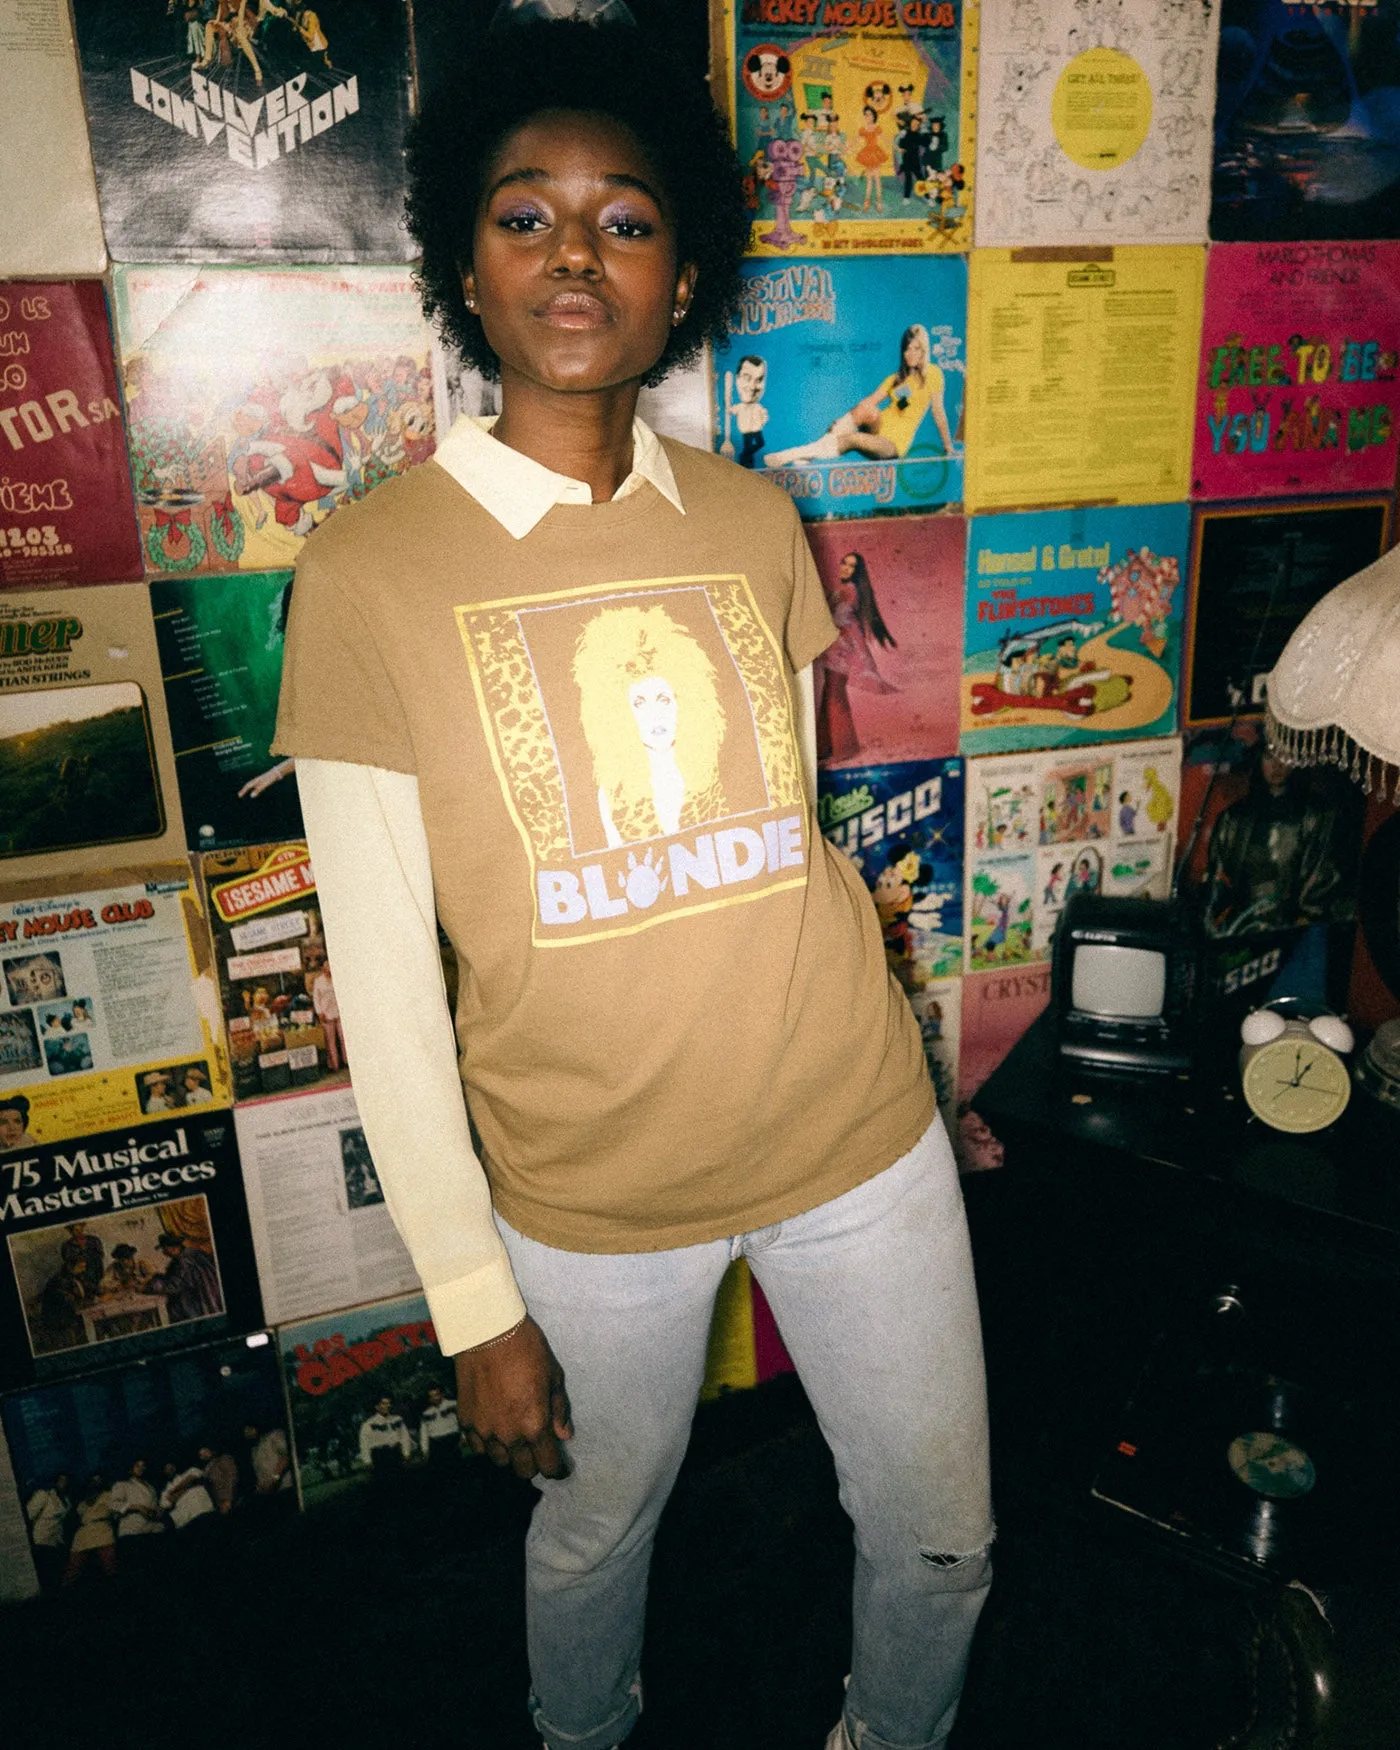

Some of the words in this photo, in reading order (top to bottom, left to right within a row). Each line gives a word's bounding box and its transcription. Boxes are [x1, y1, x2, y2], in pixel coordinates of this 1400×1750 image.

[902, 1, 955, 27] CLUB
[1295, 344, 1332, 385] TO
[1207, 413, 1271, 455] YOU
[977, 593, 1095, 622] FLINTSTONES
[23, 907, 97, 939] MOUSE
[100, 898, 155, 924] CLUB
[2, 1158, 42, 1191] 75
[53, 1128, 190, 1181] Musical
[0, 1160, 217, 1222] Masterpieces
